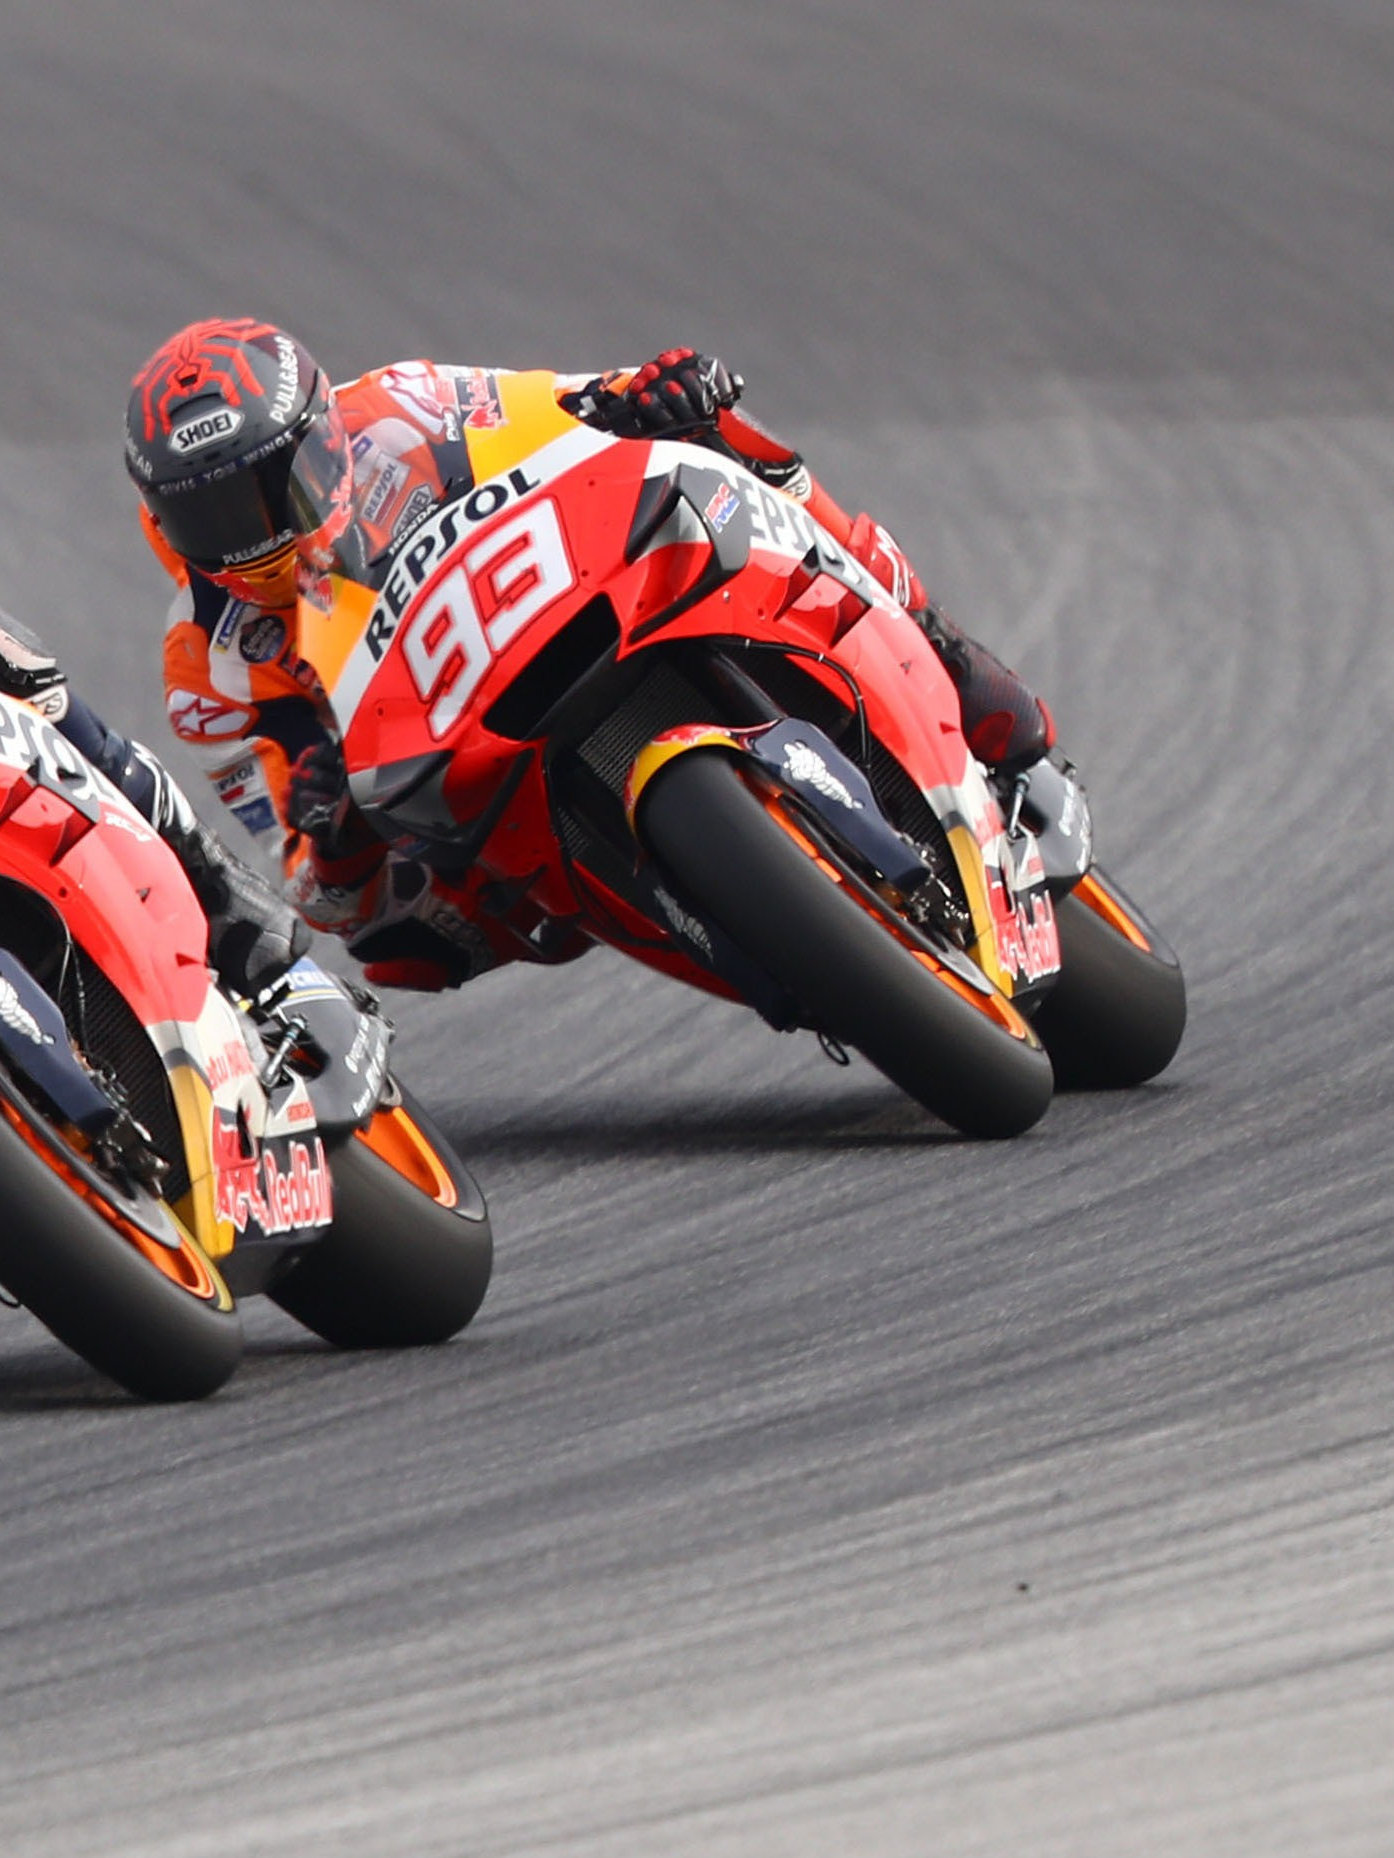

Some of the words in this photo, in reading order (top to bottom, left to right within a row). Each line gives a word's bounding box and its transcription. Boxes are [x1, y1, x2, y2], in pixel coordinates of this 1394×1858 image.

[176, 413, 232, 449] SHOEI
[365, 468, 541, 662] REPSOL
[389, 503, 440, 554] HONDA
[403, 497, 579, 742] 93
